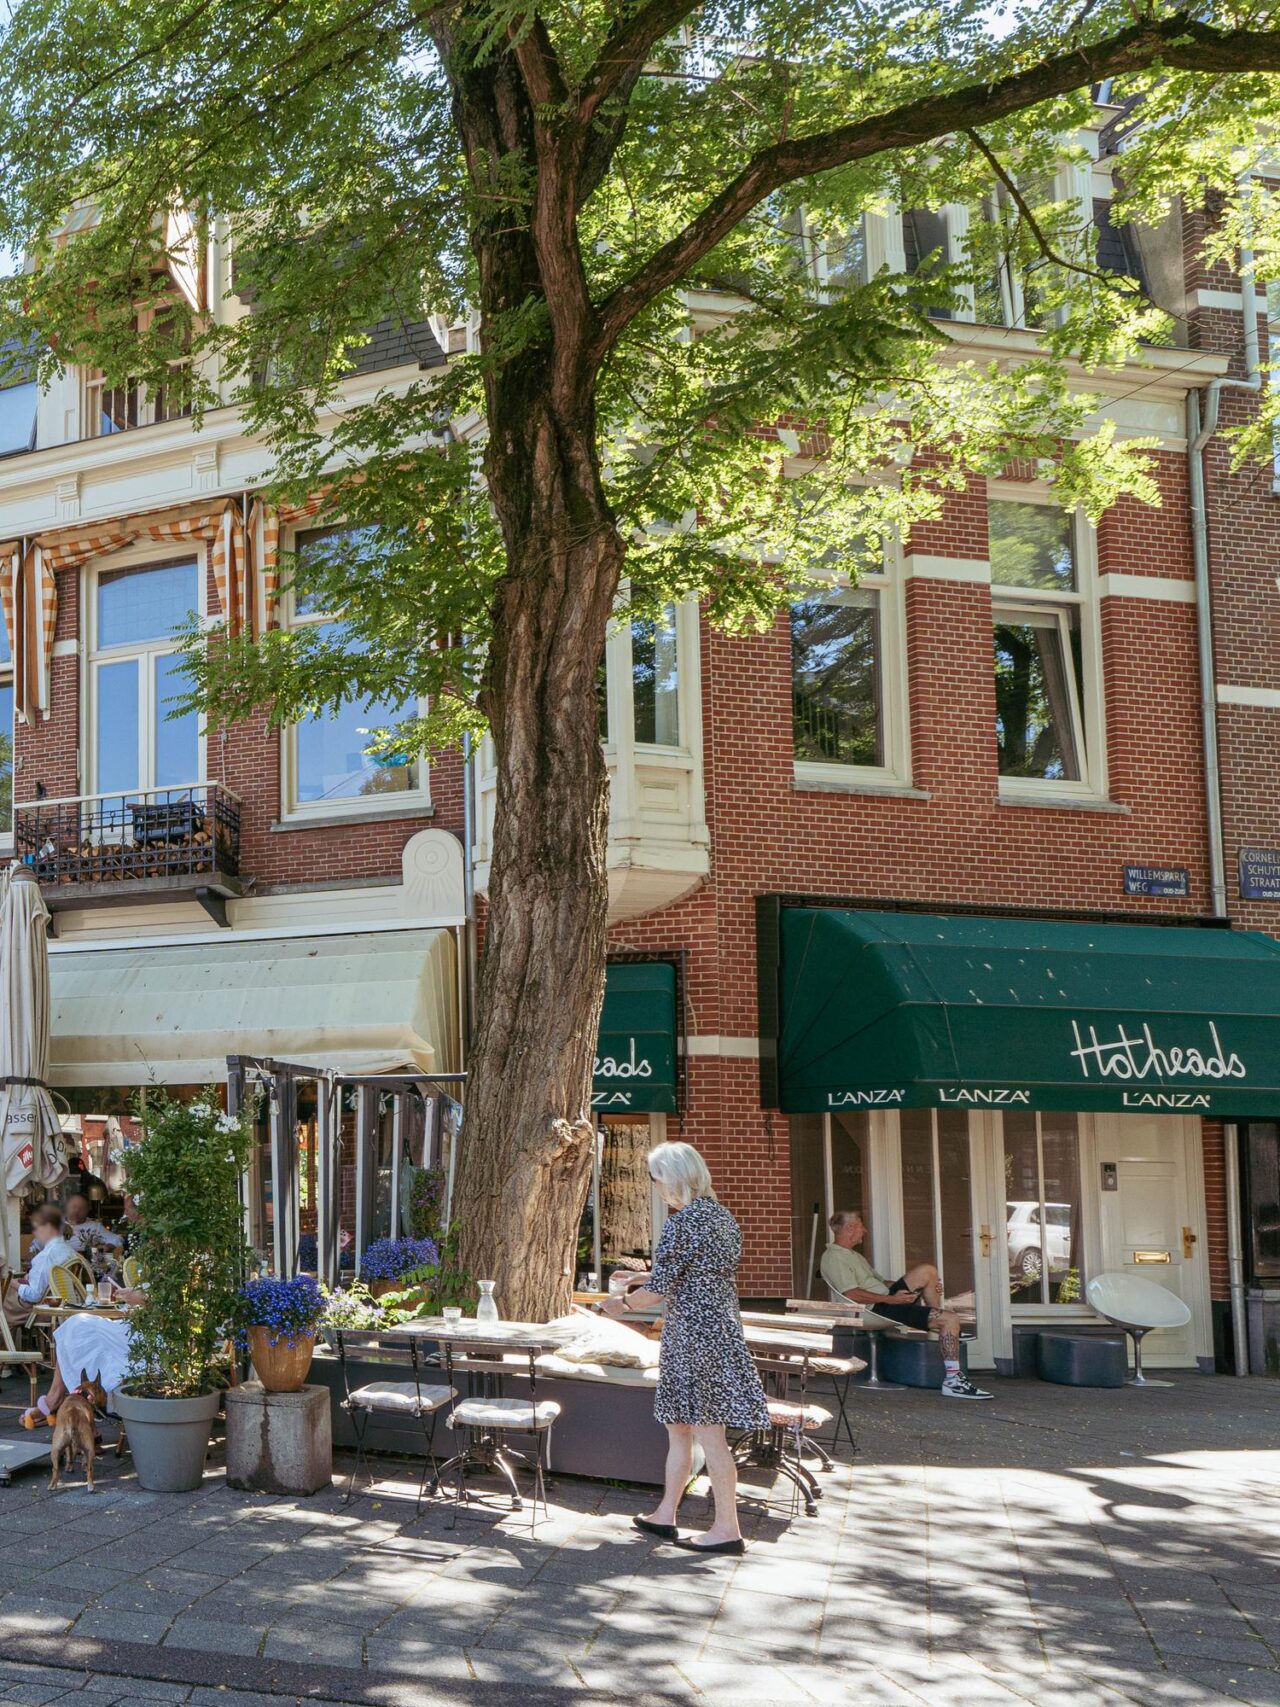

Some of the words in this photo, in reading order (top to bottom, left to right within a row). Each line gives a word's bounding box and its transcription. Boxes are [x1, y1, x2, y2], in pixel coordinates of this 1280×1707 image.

[1128, 869, 1186, 882] WILLEMSPARK
[1128, 881, 1149, 892] WEG
[1250, 877, 1280, 888] STRAAT
[1070, 1020, 1246, 1079] Hotheads
